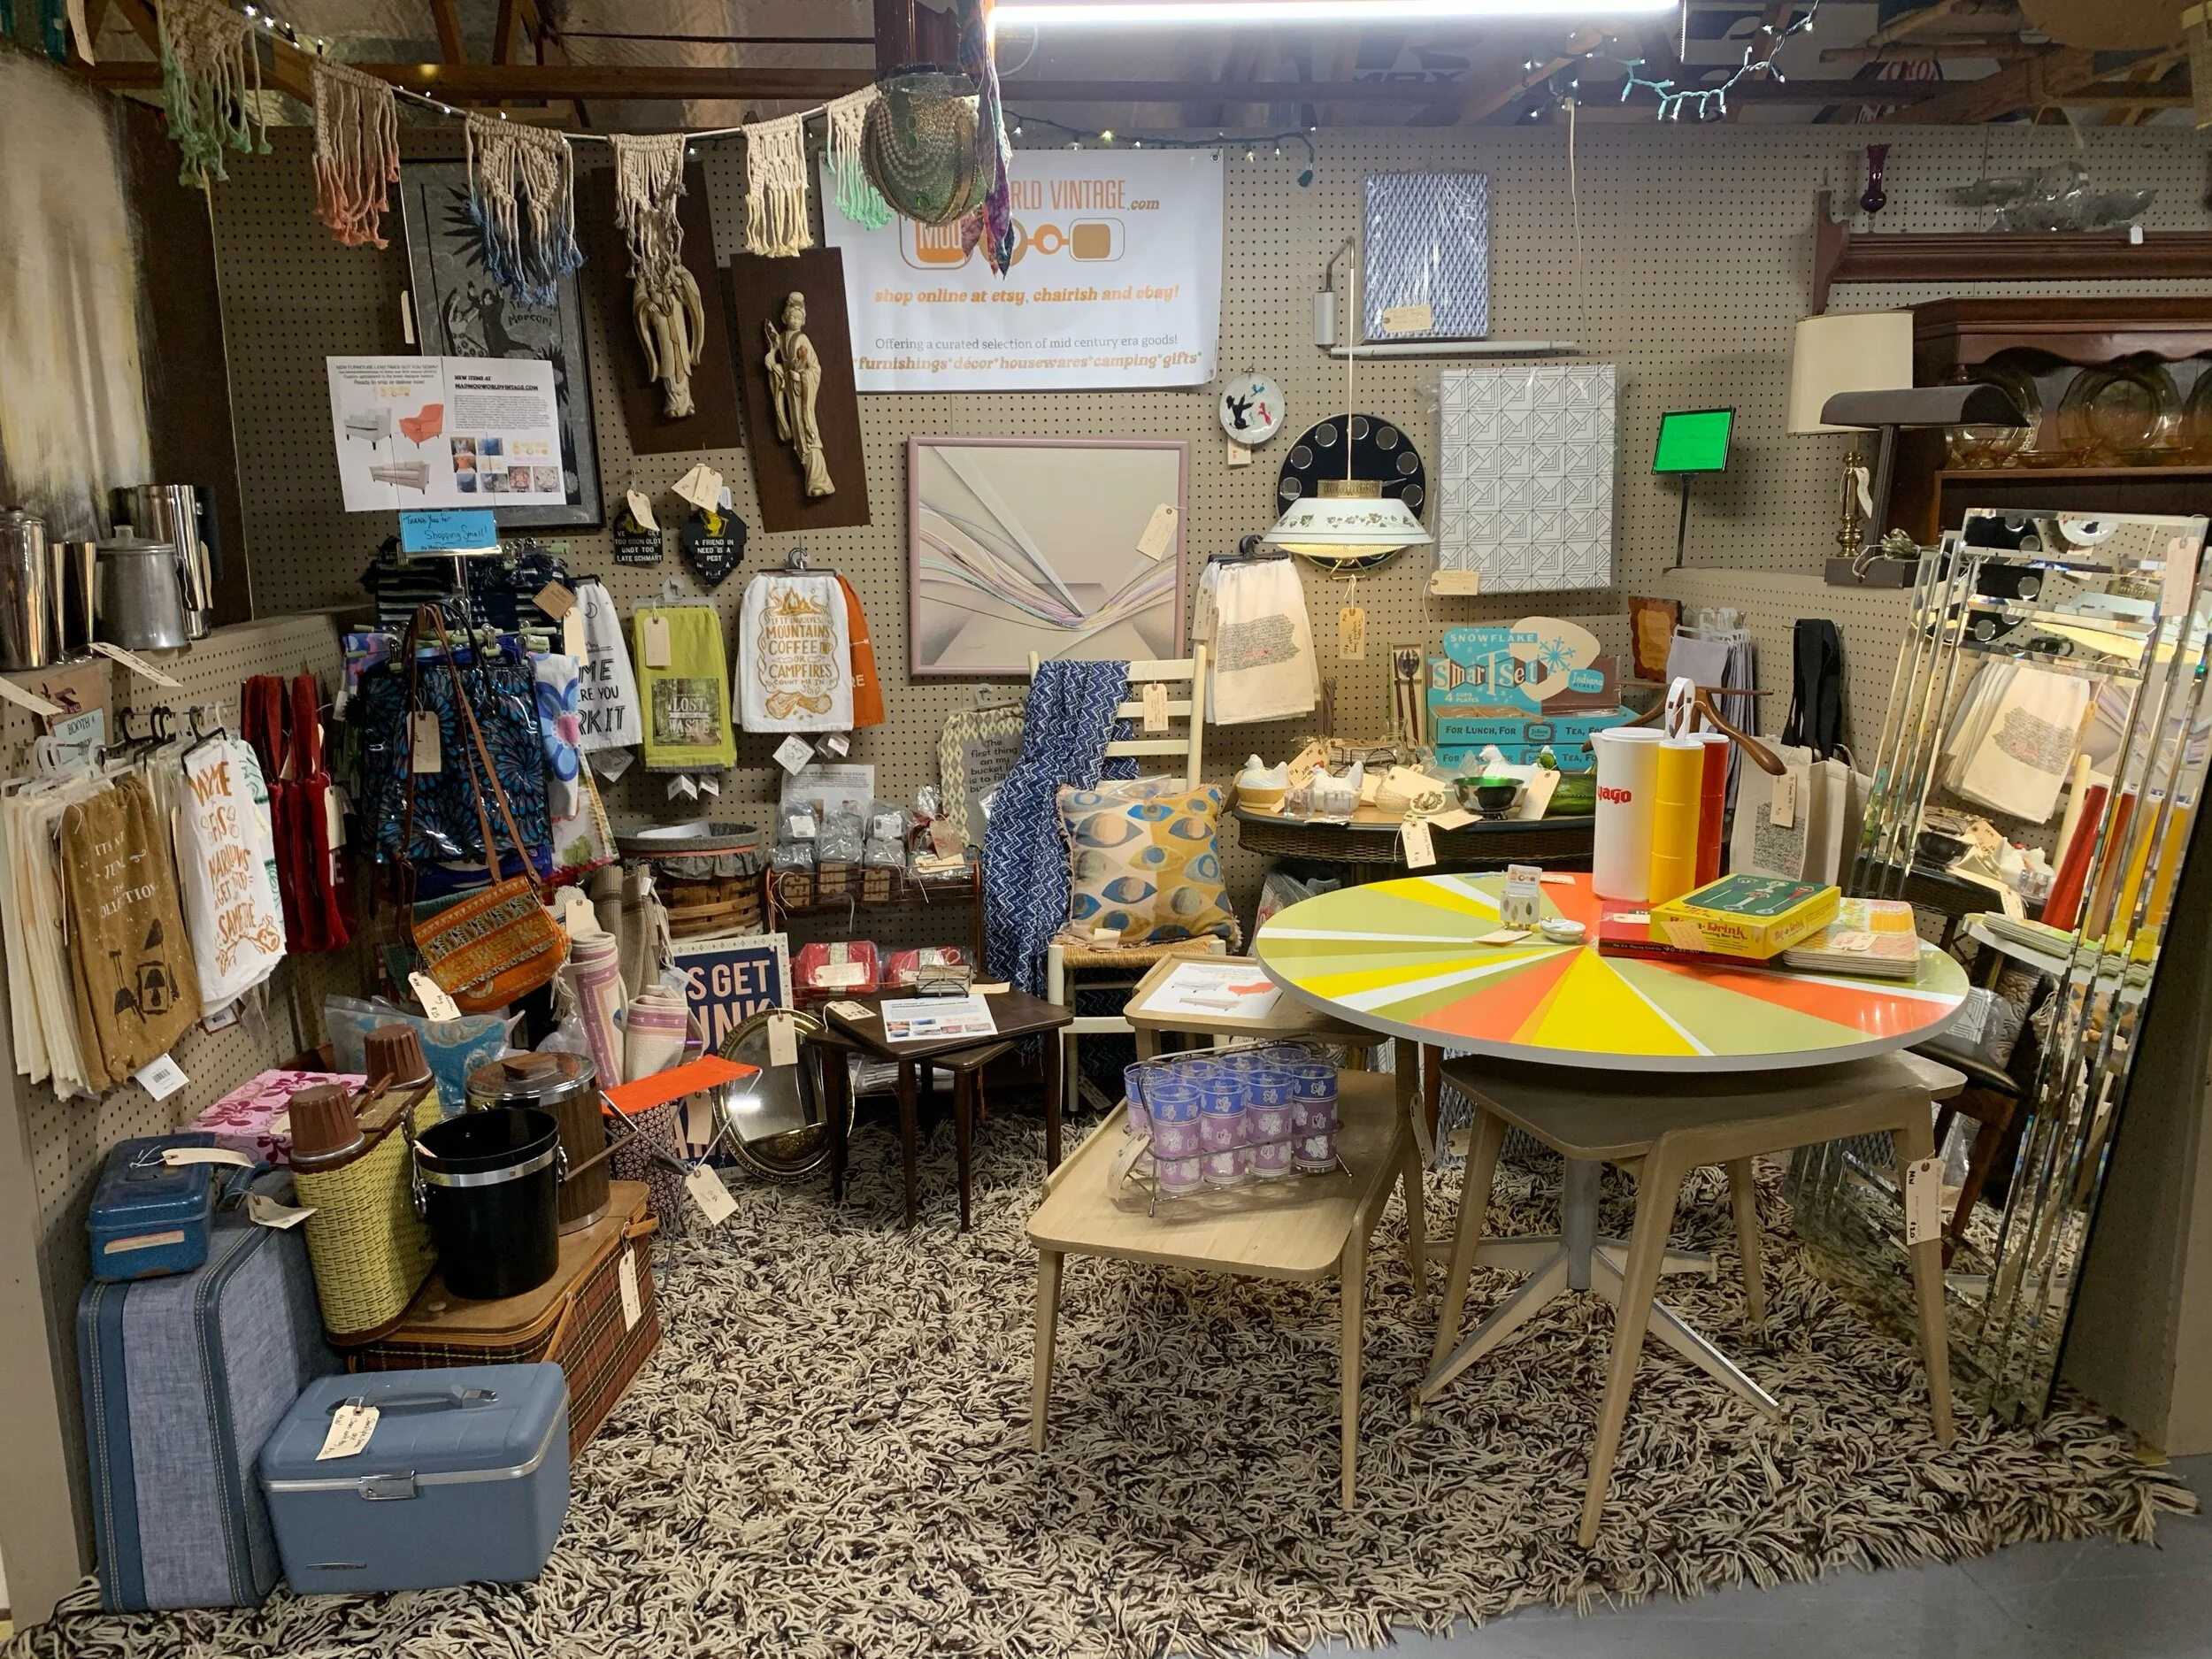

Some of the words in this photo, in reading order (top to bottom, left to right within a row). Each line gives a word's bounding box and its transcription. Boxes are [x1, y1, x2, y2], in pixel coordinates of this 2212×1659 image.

[1010, 180, 1041, 210] RLD
[874, 288, 913, 306] shop
[917, 288, 967, 303] online
[971, 290, 987, 303] at
[991, 289, 1029, 306] etsy,
[1033, 287, 1098, 302] chairish
[1102, 285, 1133, 301] and
[1136, 284, 1180, 303] ebay!
[875, 338, 924, 351] Offering
[926, 341, 933, 349] a
[935, 338, 979, 349] curated
[982, 338, 1033, 349] selection
[1035, 337, 1048, 349] of
[1050, 337, 1071, 349] mid
[1074, 336, 1118, 349] century
[1121, 337, 1140, 346] era
[1141, 334, 1178, 348] goods!
[765, 625, 830, 640] MOUNTAINS
[1450, 634, 1534, 643] SNOWFLAKE
[768, 640, 818, 656] COFFEE
[578, 658, 614, 683] ME
[768, 664, 833, 679] CAMPFIRES
[1572, 672, 1603, 686] Indiana
[598, 685, 618, 700] YOU
[1444, 693, 1453, 702] 4
[672, 697, 707, 711] LOST
[971, 749, 991, 758] first
[971, 765, 1003, 775] bucket
[1707, 922, 1747, 940] Drink
[711, 959, 771, 998] GET
